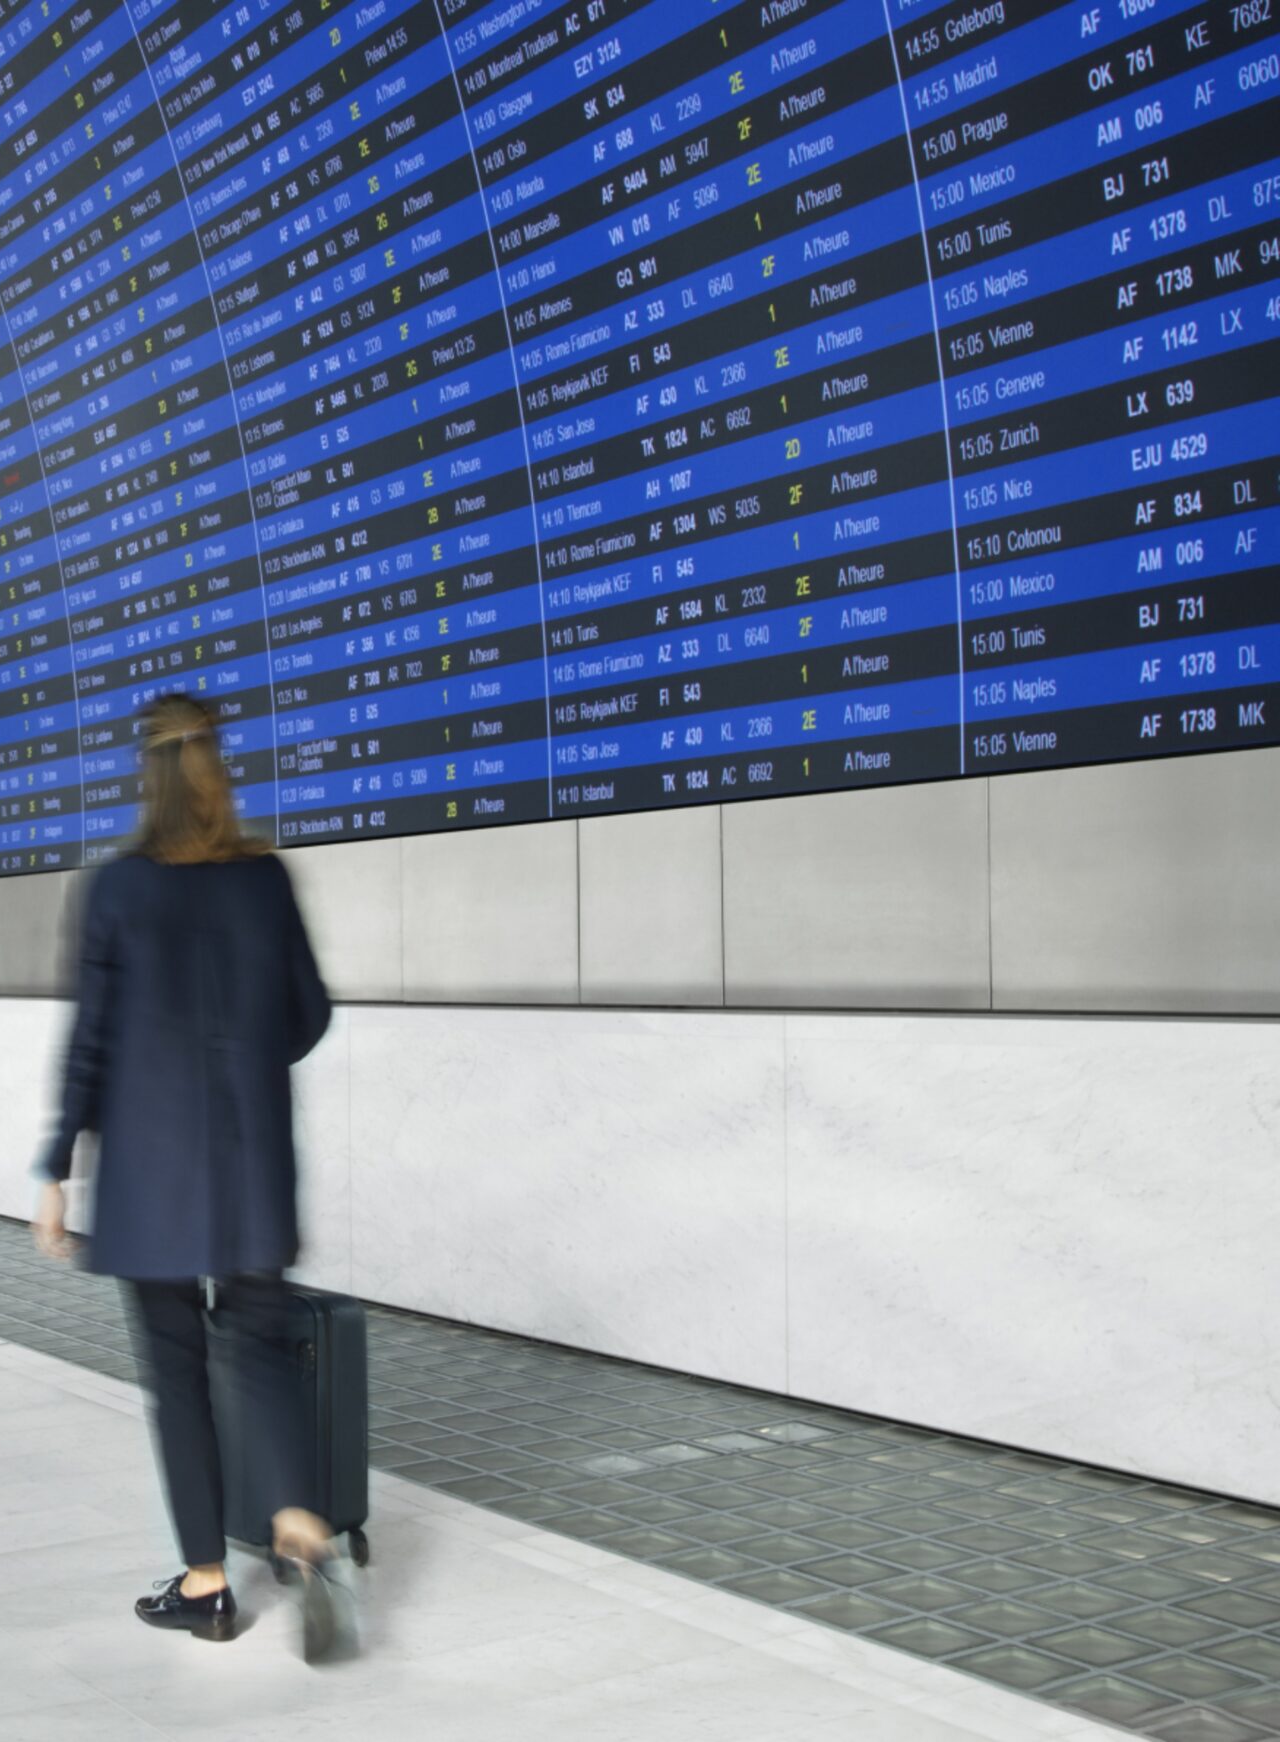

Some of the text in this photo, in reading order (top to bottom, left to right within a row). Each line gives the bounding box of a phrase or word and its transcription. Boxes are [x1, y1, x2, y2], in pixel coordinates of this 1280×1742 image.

[905, 0, 1006, 60] 14:55 Goteborg
[914, 78, 949, 110] 14:55
[953, 56, 998, 94] Madrid
[1080, 7, 1101, 38] AF
[339, 68, 347, 83] 1
[583, 97, 600, 120] SK
[606, 83, 626, 108] 834
[719, 28, 728, 48] 1
[923, 0, 1272, 161] 15:00 Prague OK 761 KE 7682
[593, 140, 606, 163] AF
[650, 112, 665, 134] KL
[676, 93, 702, 121] 2299
[728, 70, 746, 95] 2E
[930, 54, 1280, 211] 15:00 Mexico AM 006 AF 6060
[608, 225, 625, 246] VN
[631, 213, 651, 236] 018
[668, 199, 681, 221] AF
[693, 183, 719, 209] 5096
[745, 162, 763, 187] 2E
[937, 156, 1170, 260] 15:00 Tunis BJ 731
[616, 267, 634, 289] GQ
[639, 256, 658, 279] 901
[754, 212, 762, 231] 1
[944, 281, 979, 310] 15:05
[983, 269, 1029, 298] Naples
[1111, 227, 1132, 256] AF
[1149, 209, 1188, 241] 1378
[1208, 195, 1232, 222] DL
[950, 332, 984, 361] 15:05
[988, 321, 1034, 348] Vienne
[1117, 281, 1138, 310] AF
[1155, 265, 1194, 297] 1738
[1214, 249, 1243, 279] MK
[955, 382, 989, 410] 15:05
[995, 371, 1045, 399] Geneve
[1123, 336, 1144, 364] AF
[1162, 320, 1199, 351] 1142
[1220, 307, 1243, 336] LX
[960, 379, 1195, 460] 15:05 Zurich LX 639
[646, 479, 661, 500] AH
[669, 469, 692, 492] 1087
[784, 437, 801, 460] 2D
[963, 432, 1209, 510] 15:05 Nice EJU 4529
[967, 479, 1257, 560] 15:10 Cotonou AF 834 DL
[655, 605, 669, 626] AF
[679, 599, 703, 620] 1584
[714, 594, 729, 613] KL
[741, 584, 766, 608] 2332
[795, 575, 812, 597] 2E
[970, 527, 1257, 604] 15:00 Mexico AM 006 AF
[972, 595, 1204, 655] 15:00 Tunis BJ 731
[442, 689, 448, 705] 1
[973, 644, 1261, 706] 15:05 Naples AF 1378 DL
[973, 701, 1266, 757] 15:05 Vienne AF 1738 MK
[662, 773, 676, 792] TK
[685, 769, 709, 789] 1824
[721, 766, 737, 785] AC
[748, 762, 773, 783] 6692
[802, 757, 810, 777] 1
